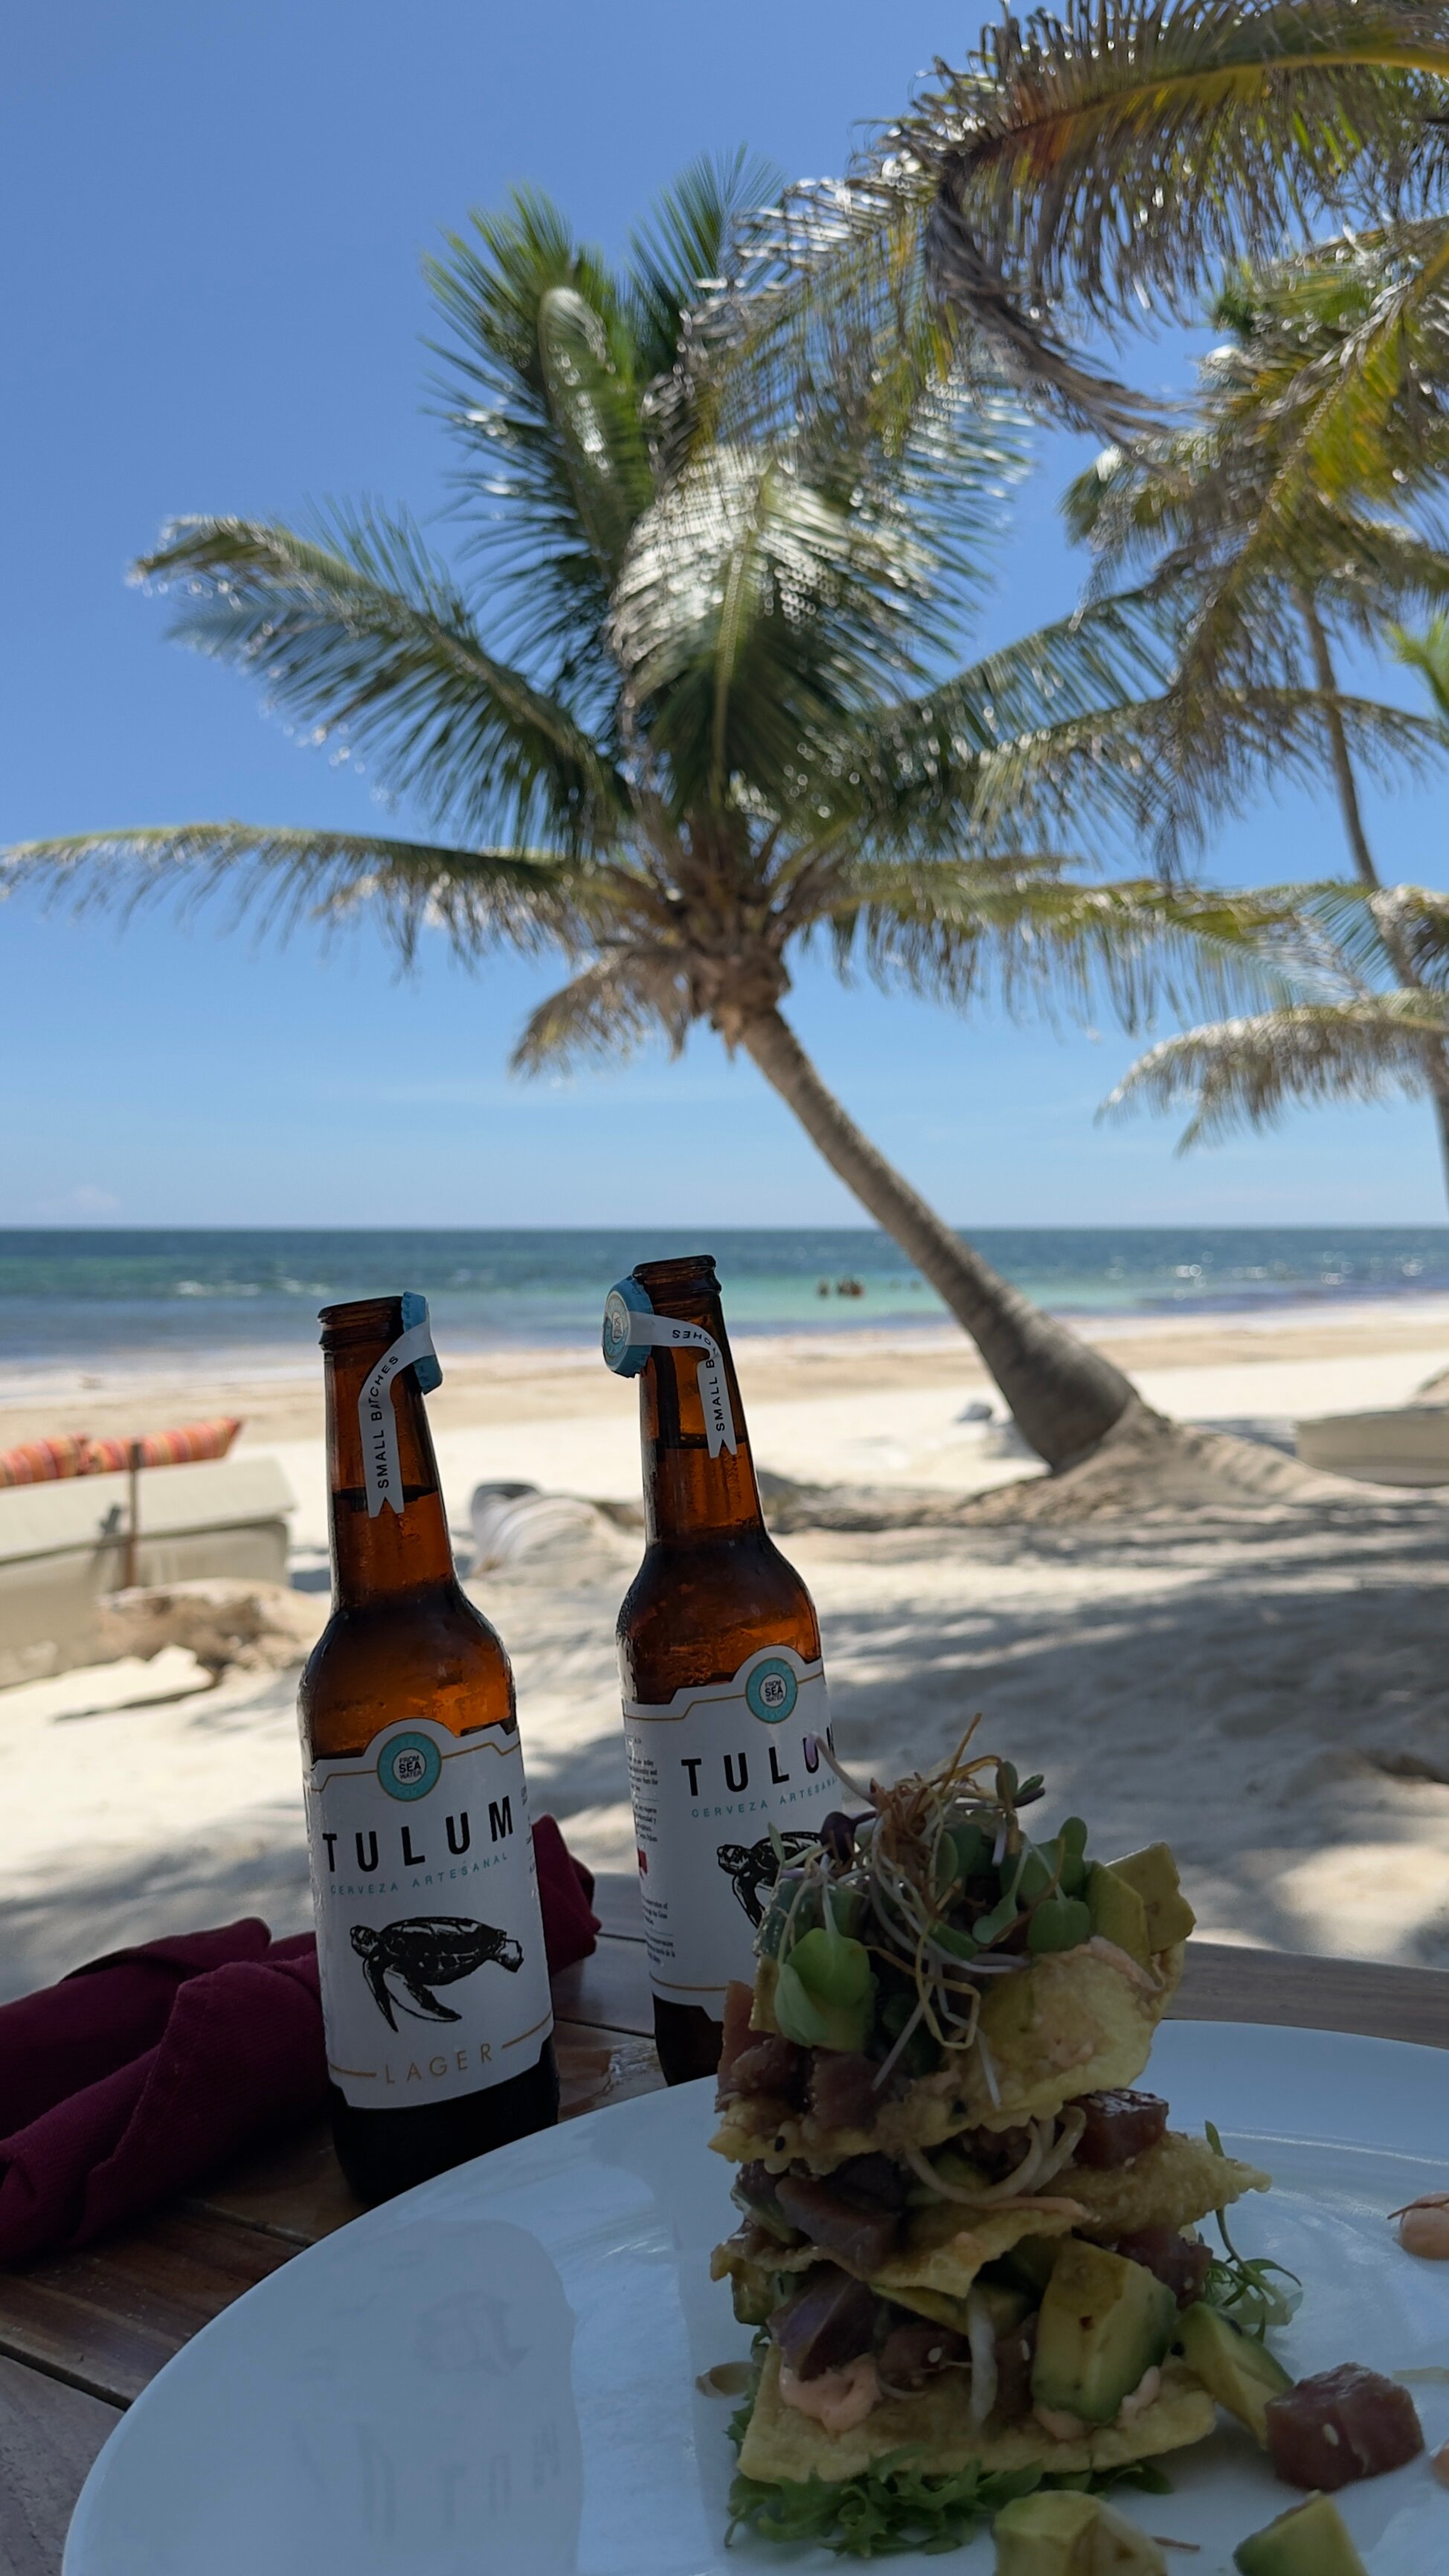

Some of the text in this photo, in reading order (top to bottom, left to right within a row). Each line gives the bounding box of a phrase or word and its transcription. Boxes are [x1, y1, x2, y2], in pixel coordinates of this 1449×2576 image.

[709, 1376, 725, 1432] SMALL
[368, 1356, 399, 1489] SMALL BATCHES
[765, 1686, 783, 1697] SEA
[399, 1755, 420, 1764] FROM
[399, 1761, 422, 1774] SEA
[399, 1768, 423, 1780] WATER
[691, 1800, 768, 1818] CERVEZA
[322, 1795, 513, 1873] TULUM
[330, 1881, 399, 1896] CERVEZA
[411, 1852, 508, 1888] ARTESANAL
[385, 2043, 492, 2085] LAGER
